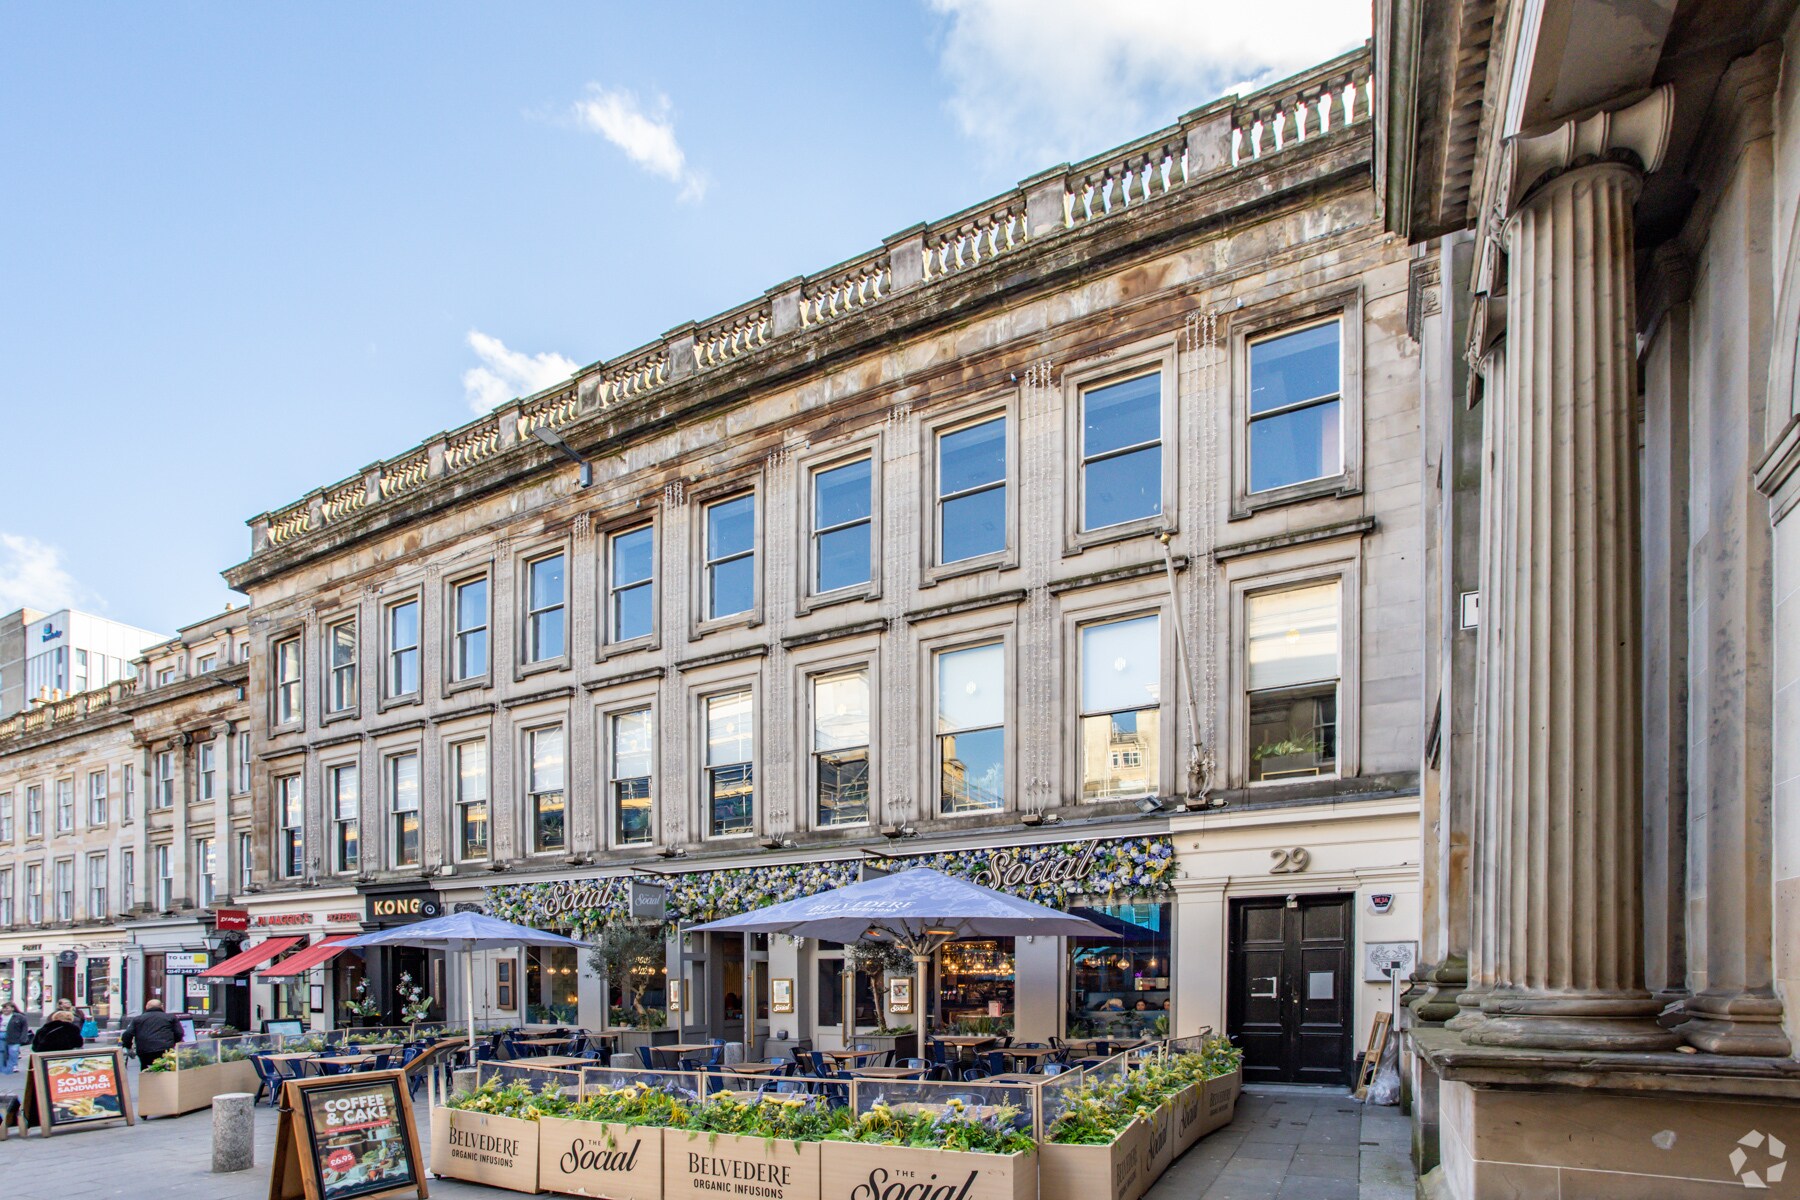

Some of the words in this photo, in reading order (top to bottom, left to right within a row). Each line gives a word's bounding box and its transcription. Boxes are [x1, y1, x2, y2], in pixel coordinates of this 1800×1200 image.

[973, 839, 1098, 891] Social
[1270, 848, 1310, 873] 29
[544, 877, 616, 917] Social
[635, 893, 661, 906] Social
[374, 899, 421, 916] KONG
[57, 1076, 96, 1087] SOUP
[98, 1074, 109, 1083] &
[57, 1082, 111, 1093] SANDWICH
[324, 1094, 385, 1112] COFFEE
[326, 1113, 343, 1125] &
[343, 1105, 388, 1121] CAKE
[449, 1127, 519, 1157] BELVEDERE
[330, 1154, 353, 1166] £6.95
[452, 1149, 477, 1161] ORGANIC
[479, 1154, 513, 1168] INFUSIONS
[560, 1138, 641, 1174] Social
[688, 1152, 791, 1186] BELVEDERE
[896, 1169, 915, 1178] THE
[693, 1178, 731, 1193] ORGANIC
[734, 1184, 783, 1199] INFUSIONS
[851, 1167, 978, 1200] Social
